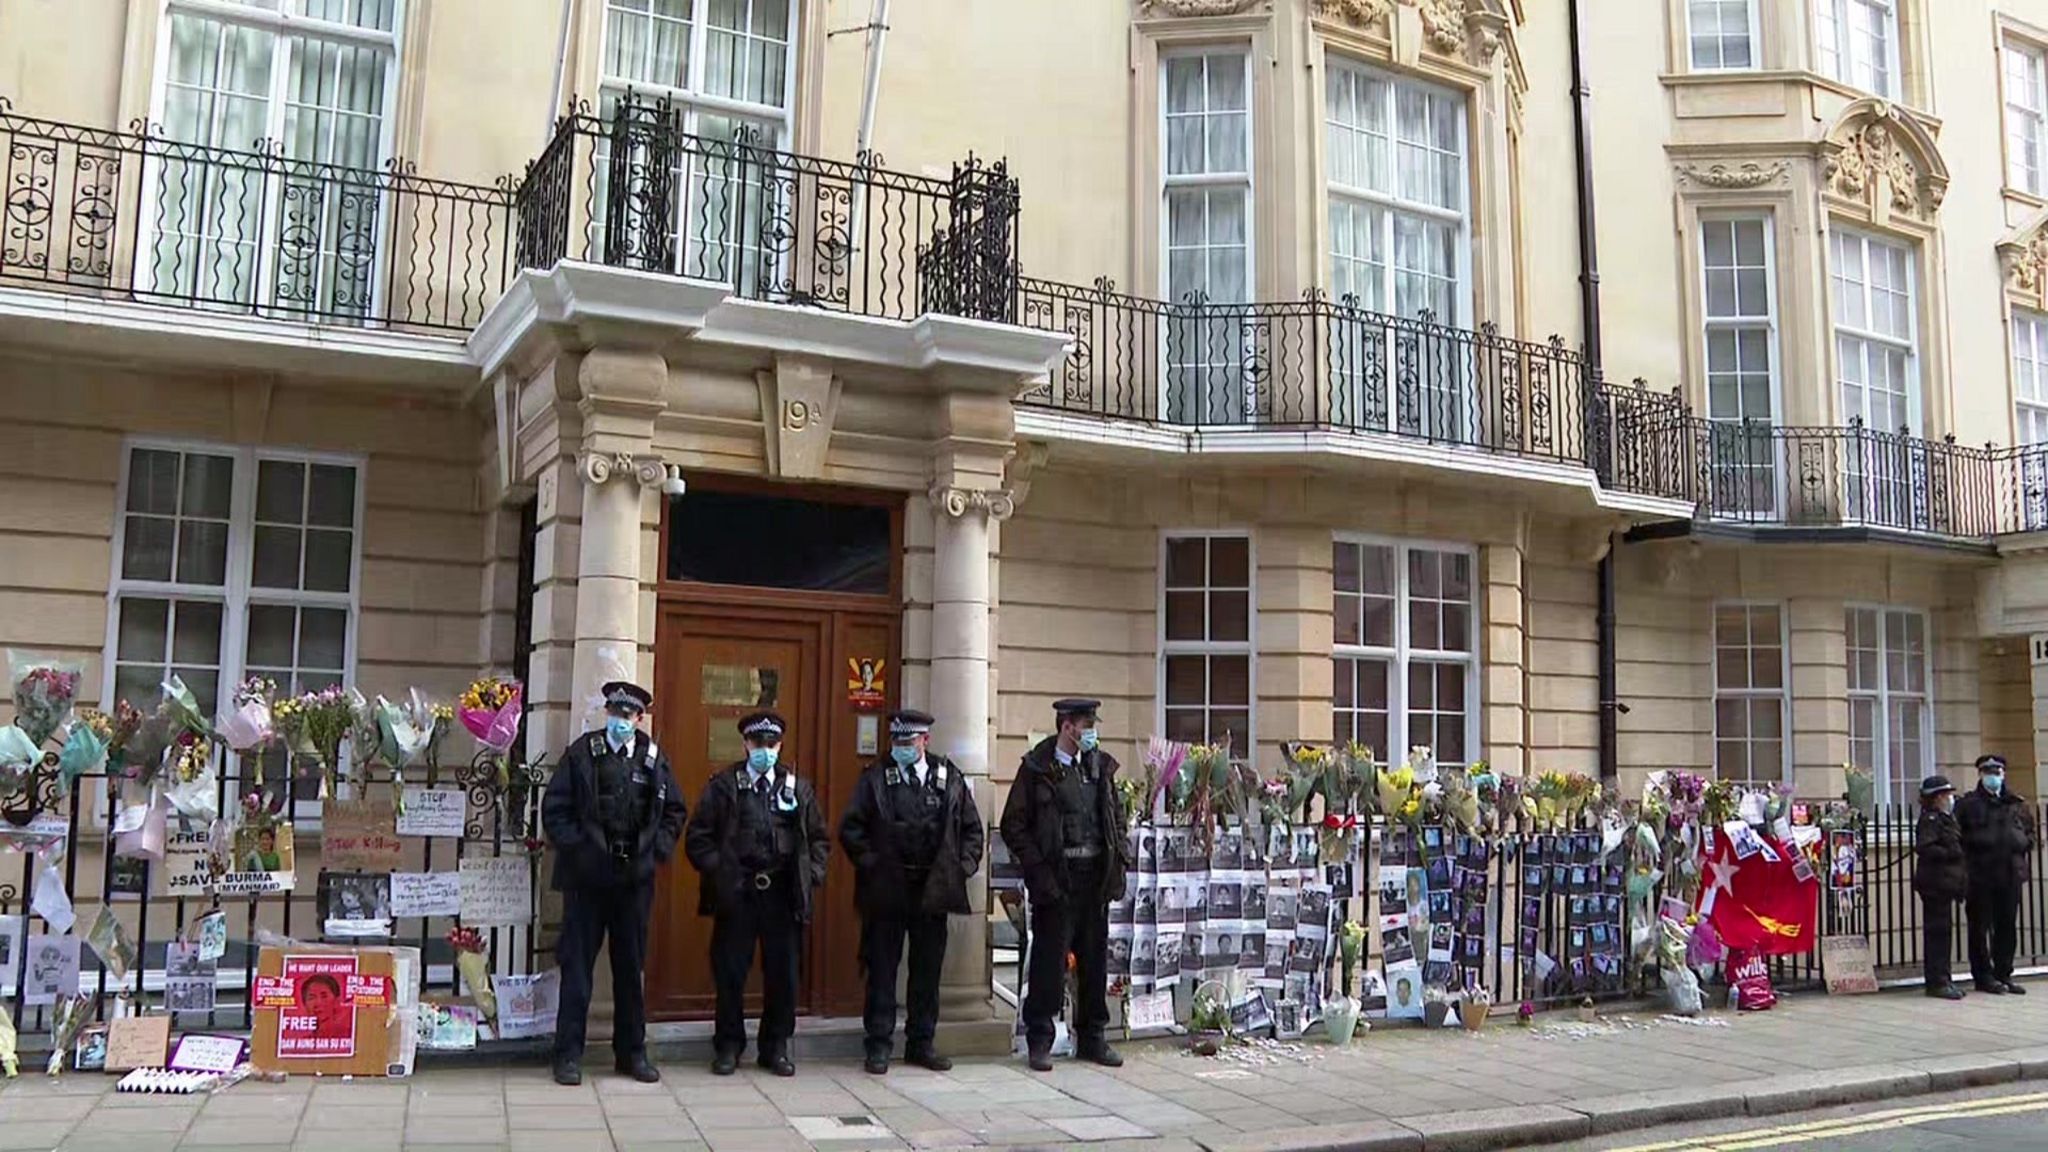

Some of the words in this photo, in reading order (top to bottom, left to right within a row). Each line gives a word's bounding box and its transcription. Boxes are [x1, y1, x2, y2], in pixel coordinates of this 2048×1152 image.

[176, 831, 209, 843] FRE
[225, 873, 272, 883] BURMA
[282, 1016, 317, 1030] FREE
